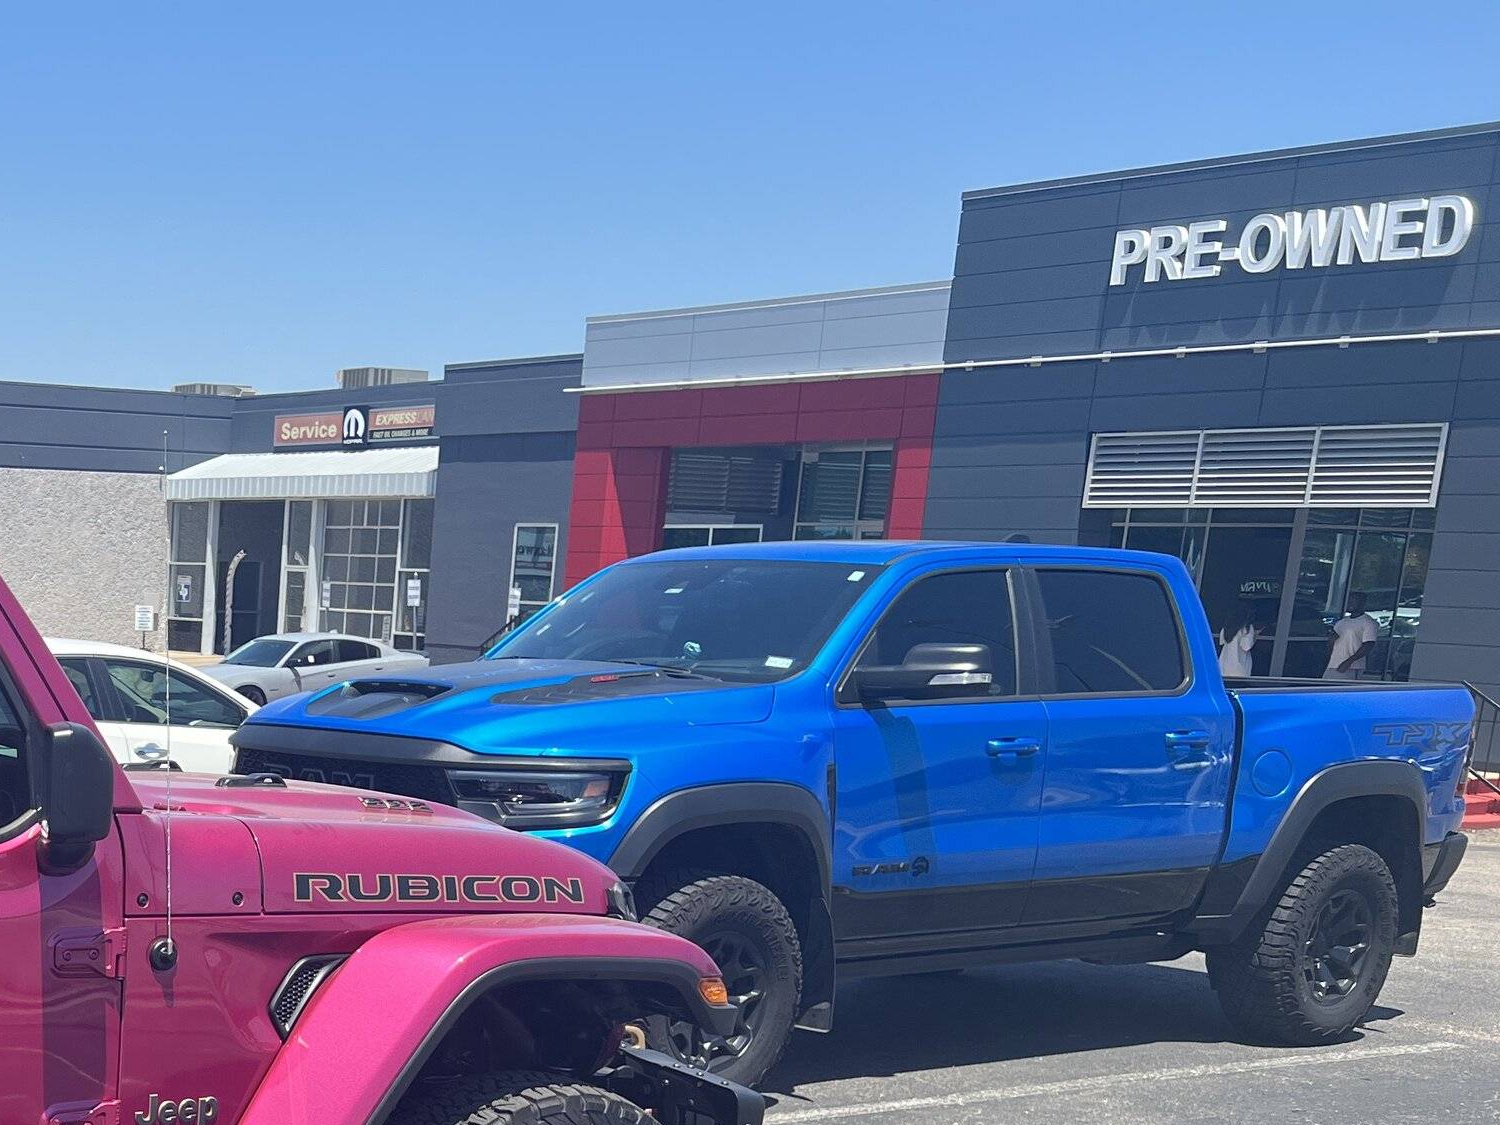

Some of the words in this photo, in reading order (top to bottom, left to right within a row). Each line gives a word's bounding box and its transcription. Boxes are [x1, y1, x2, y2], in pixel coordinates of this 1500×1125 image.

[1109, 195, 1474, 286] PRE-OWNED
[281, 421, 337, 440] Service
[293, 872, 585, 904] RUBICON
